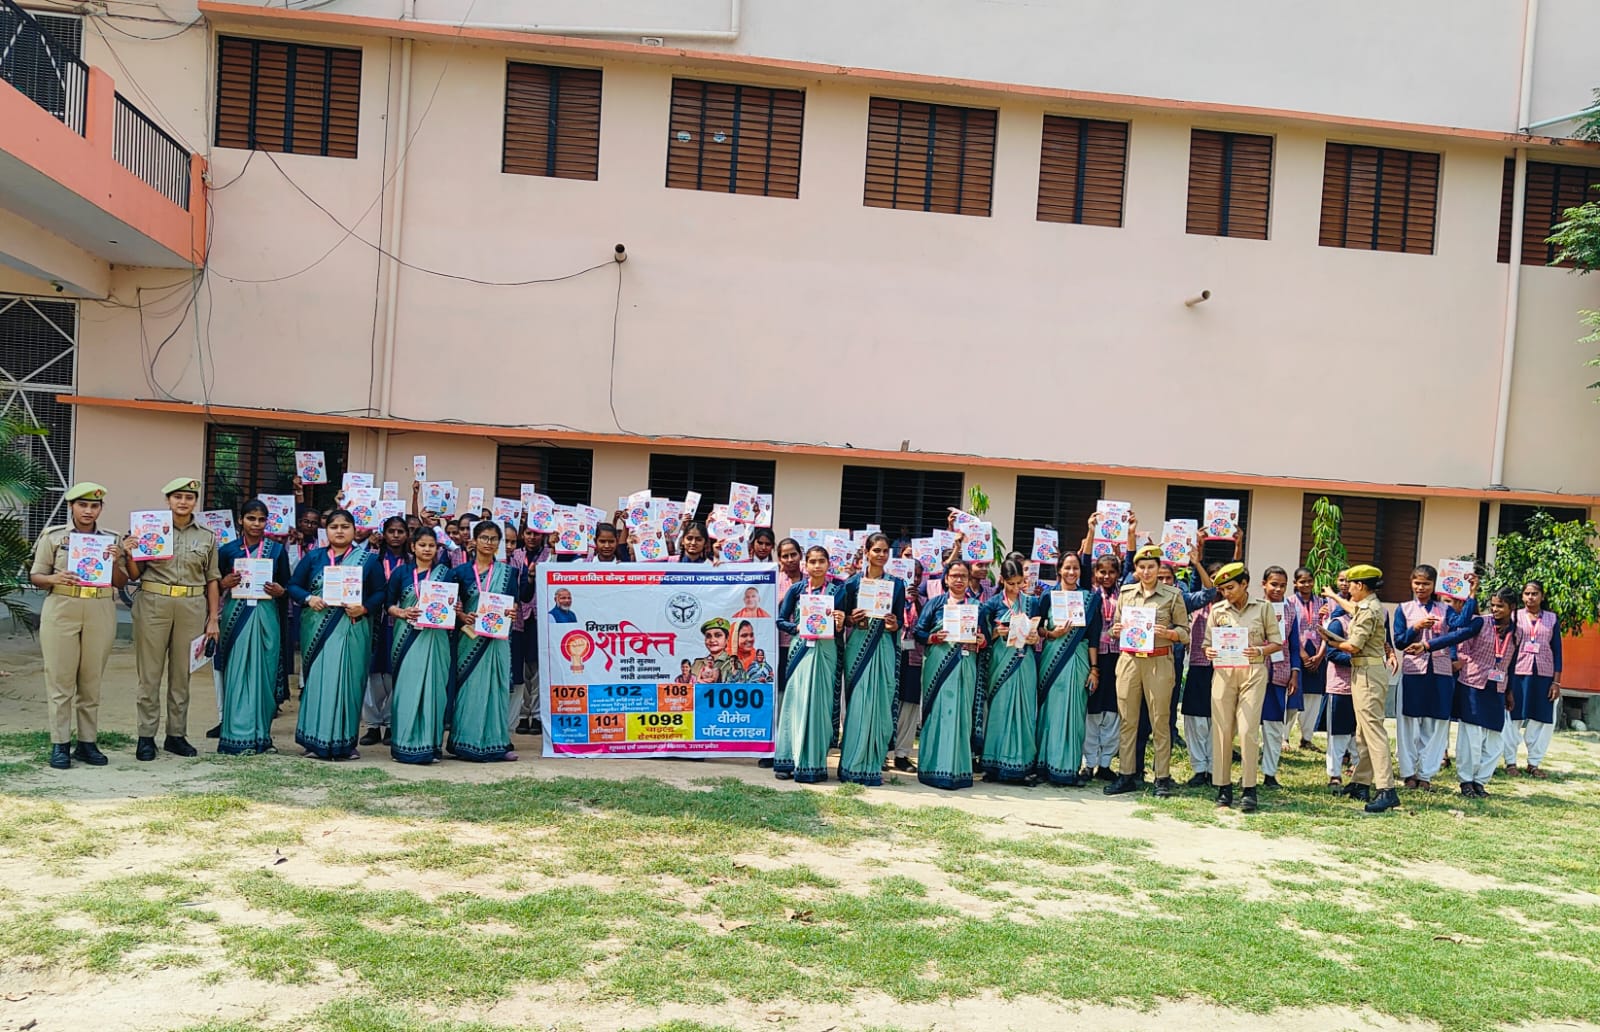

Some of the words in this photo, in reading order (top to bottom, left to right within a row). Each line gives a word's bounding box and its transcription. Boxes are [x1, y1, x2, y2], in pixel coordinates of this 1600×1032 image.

[580, 572, 603, 582] शक्ति
[585, 621, 618, 631] मिशन
[595, 621, 677, 672] शक्ति
[553, 687, 585, 698] 1076
[604, 686, 642, 697] 102
[664, 685, 688, 696] 108
[704, 688, 764, 709] 1090
[558, 716, 582, 727] 112
[595, 716, 618, 726] 101
[637, 714, 683, 725] 1098
[717, 711, 751, 723] वीमेन
[702, 725, 730, 737] पॉवर
[733, 727, 766, 738] लाइन
